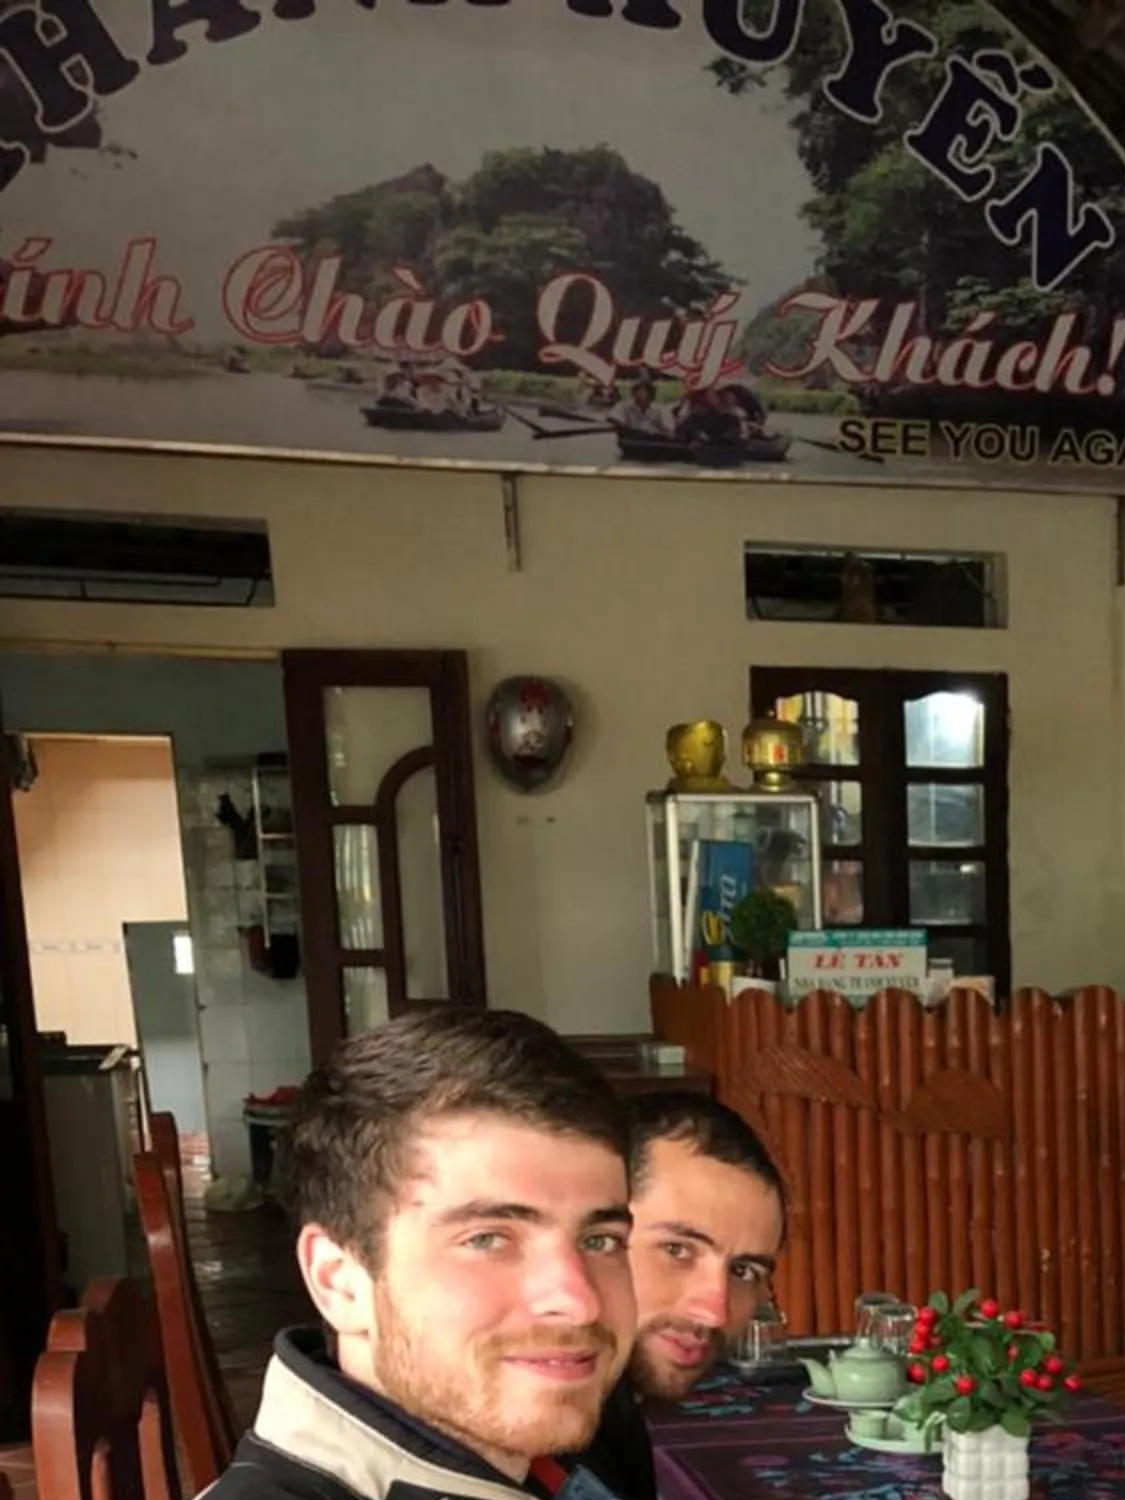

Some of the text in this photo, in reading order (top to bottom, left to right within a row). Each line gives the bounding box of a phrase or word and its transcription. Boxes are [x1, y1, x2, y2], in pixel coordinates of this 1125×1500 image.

[0, 236, 196, 335] ính
[224, 244, 503, 356] Chào
[537, 272, 744, 388] Quý
[838, 418, 931, 457] SEE
[939, 420, 1040, 464] YOU
